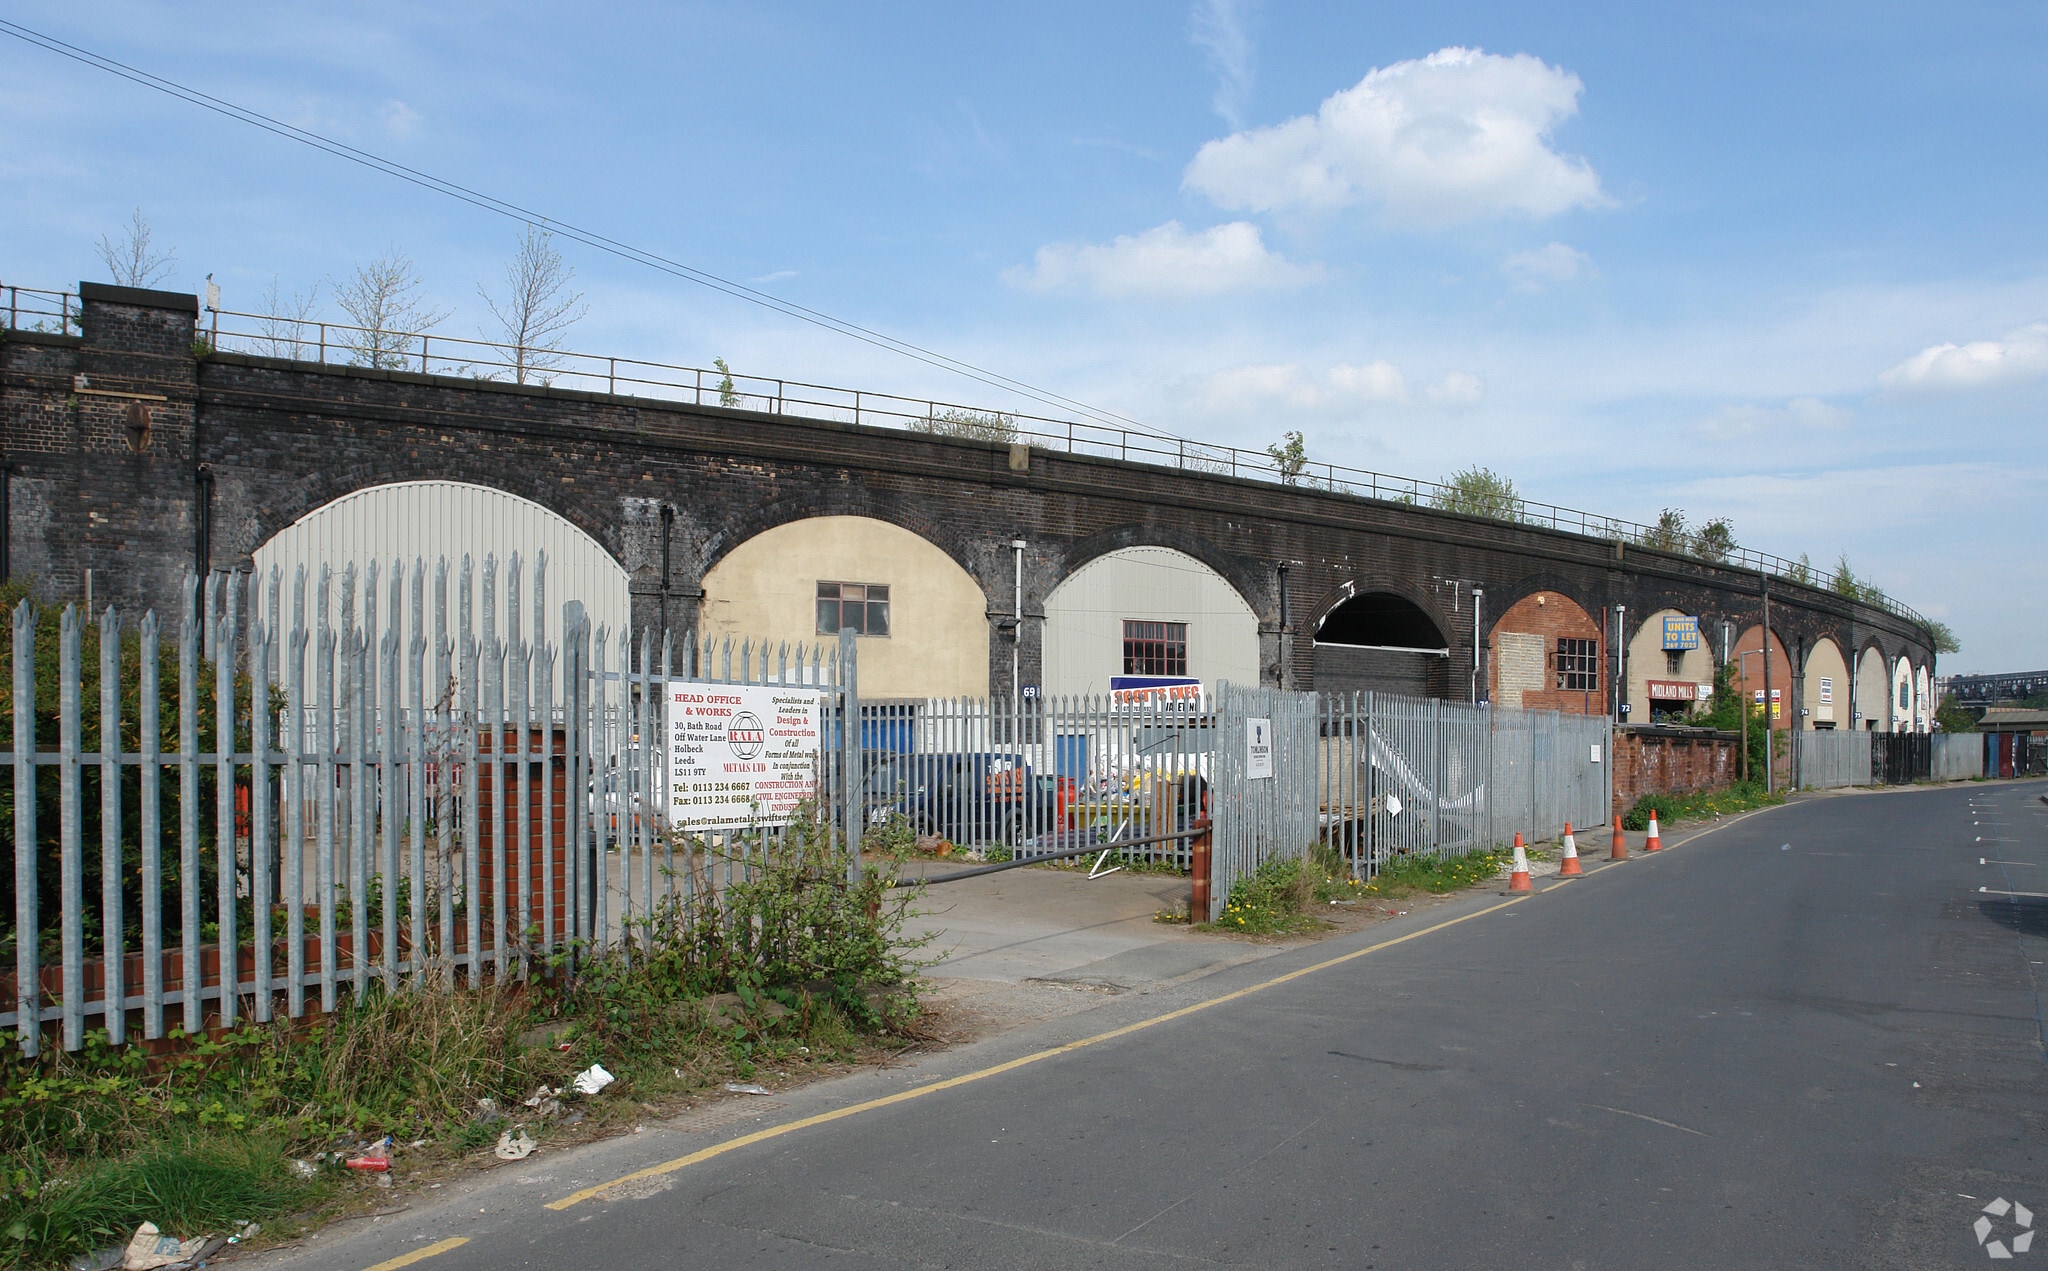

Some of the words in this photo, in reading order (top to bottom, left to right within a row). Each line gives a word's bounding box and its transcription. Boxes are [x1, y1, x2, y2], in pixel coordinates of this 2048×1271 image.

[1667, 623, 1695, 631] UNITS
[1666, 632, 1678, 641] TO
[1681, 632, 1697, 641] LET
[1023, 687, 1035, 697] 69
[1169, 686, 1199, 700] EXEC
[1652, 684, 1677, 697] MIDLAND
[1678, 686, 1693, 698] MILLS
[674, 694, 704, 703] HEAD
[707, 695, 742, 704] OFFICE
[771, 696, 802, 705] Specialists
[685, 707, 693, 715] &
[695, 707, 732, 716] WORKS
[778, 706, 801, 714] Leaders
[776, 716, 801, 727] Design
[803, 717, 809, 725] &
[674, 722, 686, 731] 30,
[687, 722, 703, 730] Bath
[705, 722, 722, 730] Road
[674, 732, 686, 741] Off
[687, 733, 708, 741] Water
[710, 734, 727, 742] Lane
[729, 731, 762, 741] RALA
[769, 728, 816, 737] Construction
[784, 739, 791, 747] Of
[791, 739, 800, 747] all
[674, 744, 704, 753] Holbeck
[765, 750, 783, 758] Forms
[782, 750, 789, 758] of
[789, 750, 805, 758] Metal
[674, 756, 695, 764] Leeds
[723, 763, 750, 772] METALS
[752, 763, 766, 772] LTD
[779, 761, 810, 771] conjunction
[674, 768, 691, 776] LS11
[693, 768, 706, 776] 9TY
[780, 772, 793, 780] With
[794, 772, 803, 780] the
[673, 782, 689, 792] Tel:
[692, 783, 713, 792] 0113
[714, 782, 729, 791] 234
[731, 782, 750, 791] 6667
[754, 781, 803, 789] CONSTRUCTION
[804, 780, 815, 788] AN
[673, 796, 691, 806] Fax:
[692, 796, 713, 805] 0113
[714, 795, 729, 804] 234
[731, 795, 750, 804] 6668
[755, 793, 774, 801] CIVIL
[774, 792, 815, 800] ENGINEERIN
